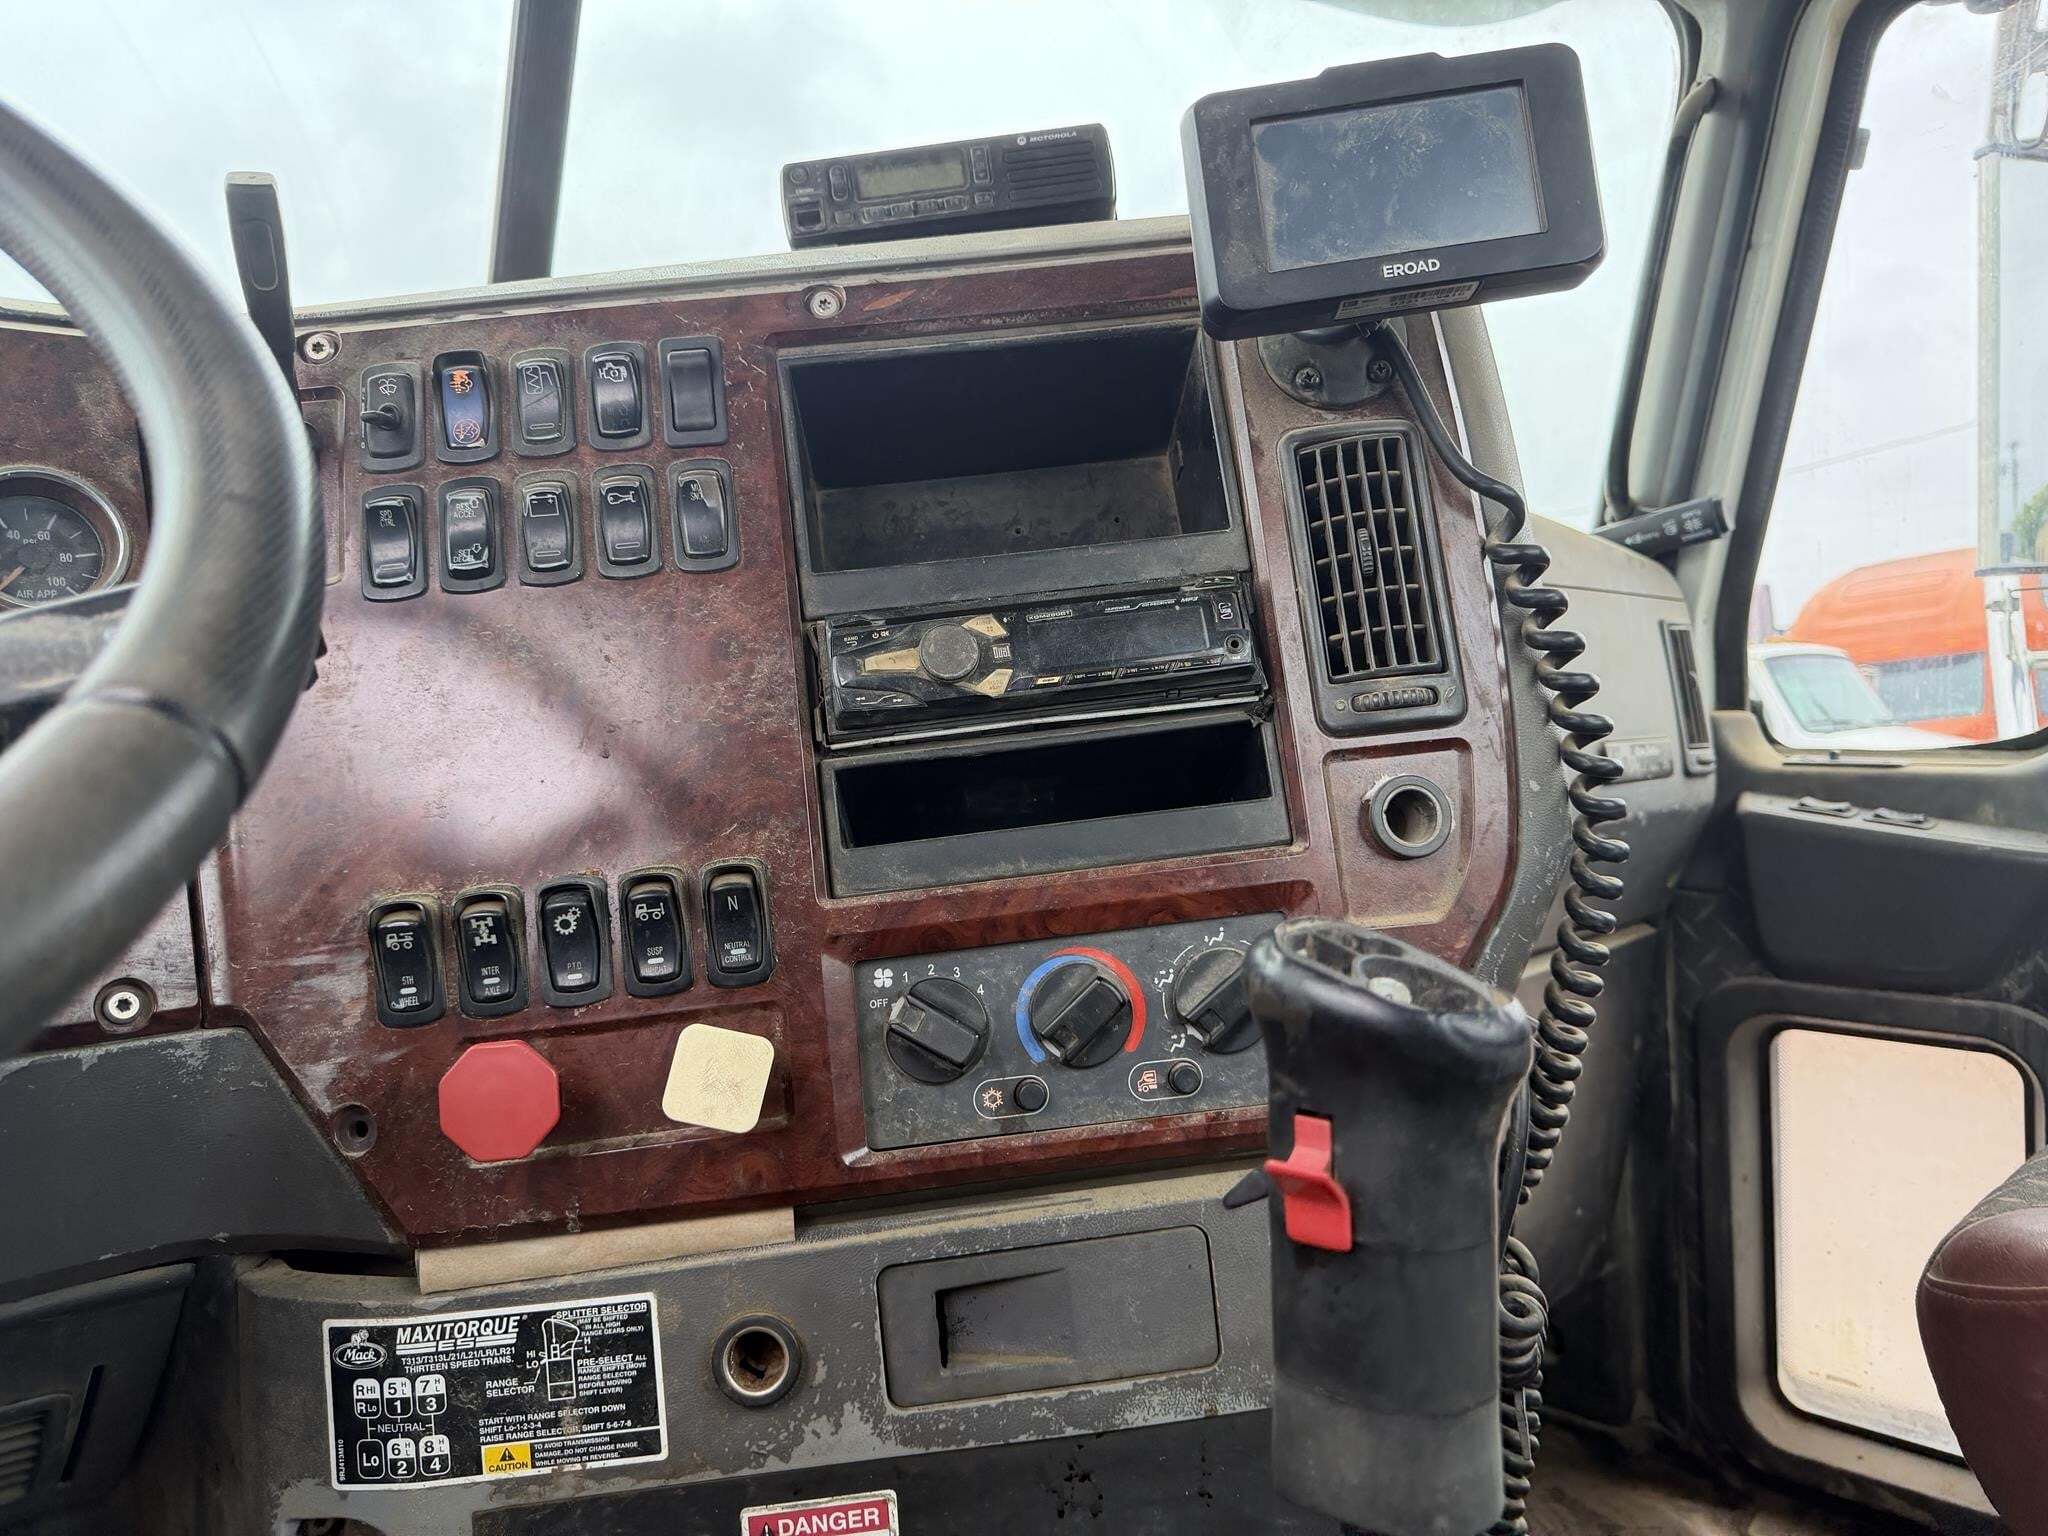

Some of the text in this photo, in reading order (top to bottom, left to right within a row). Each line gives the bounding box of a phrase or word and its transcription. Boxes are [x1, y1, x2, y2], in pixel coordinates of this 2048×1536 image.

[1030, 131, 1077, 142] MOTOROLA
[1382, 259, 1441, 278] EROAD
[380, 509, 393, 519] SPD
[380, 519, 396, 528] CTRL
[7, 530, 20, 540] 40
[37, 531, 50, 541] 60
[59, 553, 73, 563] 80
[47, 576, 66, 587] 100
[16, 589, 34, 598] AIR
[727, 895, 738, 911] N
[647, 946, 664, 956] SUSP
[724, 941, 750, 950] NEUTRAL
[725, 954, 752, 963] CONTROL
[481, 966, 500, 976] INTER
[927, 964, 935, 975] 2
[953, 967, 960, 978] 3
[402, 976, 414, 985] 5TH
[902, 971, 908, 983] 1
[484, 986, 501, 996] AXLE
[977, 984, 984, 995] 4
[399, 996, 420, 1008] WHEEL
[869, 998, 889, 1009] OFF
[556, 1302, 648, 1319] SPLITTER SELECTOR
[602, 1314, 628, 1322] SHIFTED
[396, 1316, 521, 1345] MAXITORQUE
[581, 1325, 644, 1336] RANGE GEARS ONLY)
[343, 1347, 377, 1364] Mack
[526, 1350, 536, 1359] HI
[404, 1356, 514, 1374] THIRTEEN SPEED TRANS.
[526, 1360, 539, 1369] LO
[577, 1354, 633, 1367] PRE-SELECT
[577, 1366, 601, 1374] RANGE
[602, 1364, 625, 1372] SHIFTS
[578, 1370, 637, 1382] RANGE SELECTOR
[387, 1382, 398, 1396] 5
[420, 1380, 430, 1393] 7
[485, 1378, 519, 1389] RANGE
[578, 1378, 633, 1389] BEFORE MOVING
[356, 1385, 376, 1396] R HI
[486, 1385, 535, 1398] SELECTOR
[579, 1386, 623, 1397] SHIFT LEVER)
[357, 1402, 377, 1413] R Lo
[393, 1400, 401, 1413] 1
[426, 1397, 437, 1411] 3
[478, 1403, 626, 1426] START WITH RANGE SELECTOR DOWN
[377, 1422, 426, 1433] NEUTRAL
[479, 1426, 502, 1434] SHIFT
[480, 1433, 504, 1443] RAISE
[506, 1431, 535, 1440] RANGE
[582, 1422, 605, 1432] SHIFT
[606, 1419, 632, 1429] 5-6-7-8
[424, 1440, 434, 1453] 8
[544, 1441, 563, 1449] AVOID
[563, 1436, 610, 1446] TRANSMISSION
[588, 1444, 615, 1452] CHANGE
[616, 1441, 639, 1449] RANGE
[391, 1443, 401, 1456] 6
[363, 1452, 379, 1467] Lo
[430, 1457, 441, 1471] 4
[556, 1456, 581, 1464] MOVING
[397, 1460, 408, 1475] 2
[488, 1461, 528, 1473] CAUTION
[777, 1507, 880, 1536] DANGER
